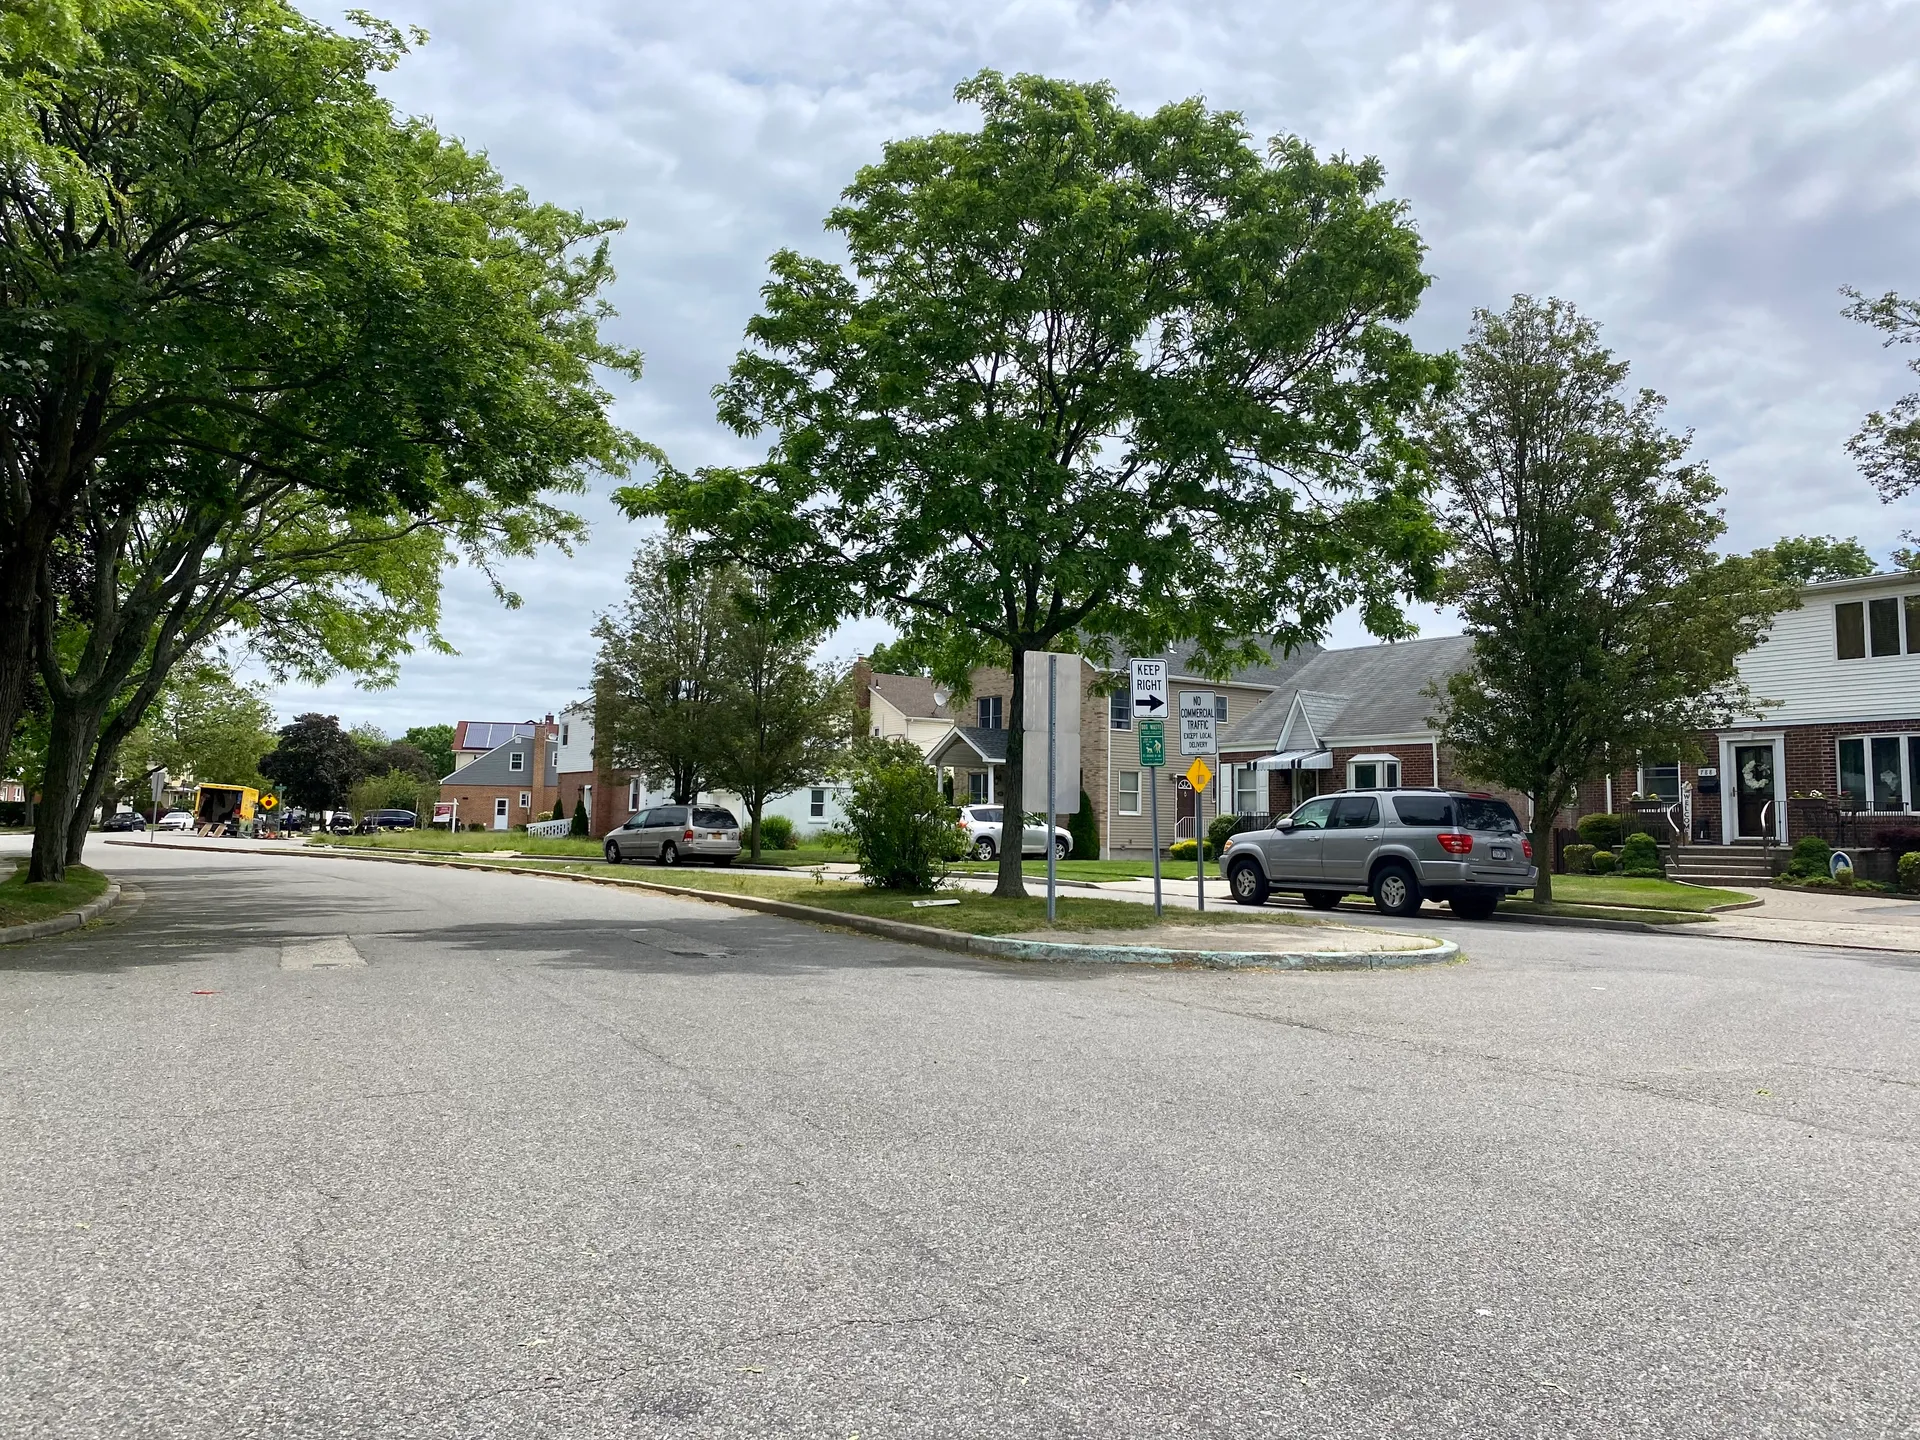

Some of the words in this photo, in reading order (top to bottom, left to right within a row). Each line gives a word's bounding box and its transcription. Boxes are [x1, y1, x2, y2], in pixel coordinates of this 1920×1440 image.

[1137, 664, 1160, 675] KEEP
[1137, 679, 1161, 690] RIGHT
[1193, 696, 1201, 706] NO
[1181, 708, 1214, 718] COMMERCIAL
[1187, 720, 1208, 729] TRAFFIC
